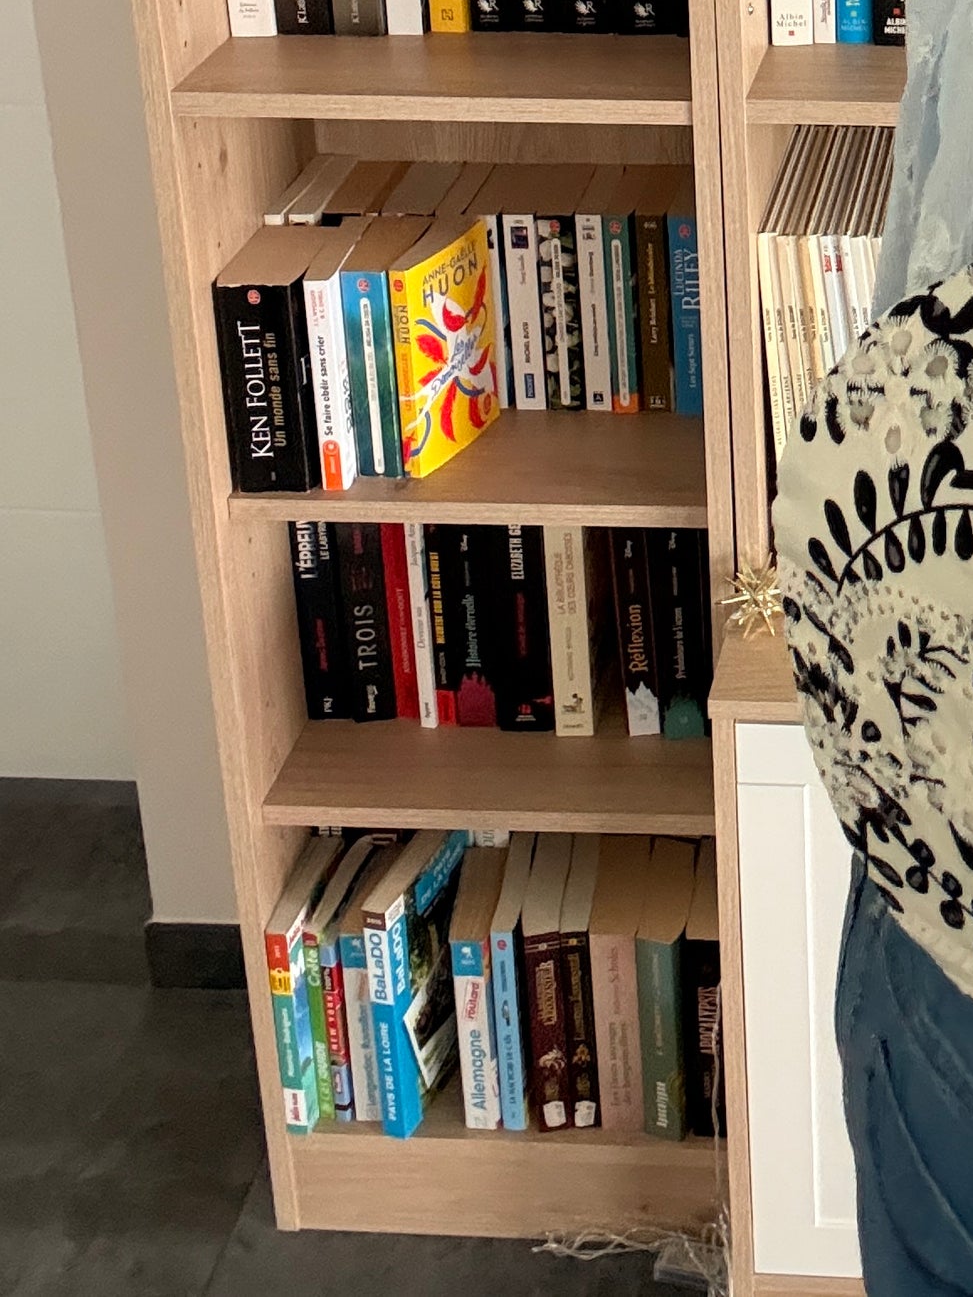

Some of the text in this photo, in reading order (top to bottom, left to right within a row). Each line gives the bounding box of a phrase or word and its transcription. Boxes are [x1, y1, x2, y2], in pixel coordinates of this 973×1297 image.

[777, 20, 807, 28] Michel
[422, 253, 479, 309] HUON
[672, 249, 683, 295] LUCINDA
[681, 248, 701, 310] RILEY
[237, 320, 275, 459] KEN FOLLETT
[264, 332, 287, 447] Un monde sans fin
[315, 335, 334, 436] Se faire obéir sans crier
[320, 551, 330, 560] LE
[509, 538, 524, 579] ELIZABETH
[353, 604, 378, 671] TROIS
[462, 594, 481, 667] Histoire éternelle
[628, 604, 648, 672] Réflexion
[370, 933, 387, 1002] BaLaDO
[390, 922, 406, 996] BaLaDO
[465, 981, 480, 1020] routard
[698, 986, 718, 1054] APOCALYPSIS
[380, 1022, 397, 1121] PAYS DE LA LOIRE
[469, 1029, 487, 1111] Allemagne
[655, 1081, 669, 1128] Apocalypse
